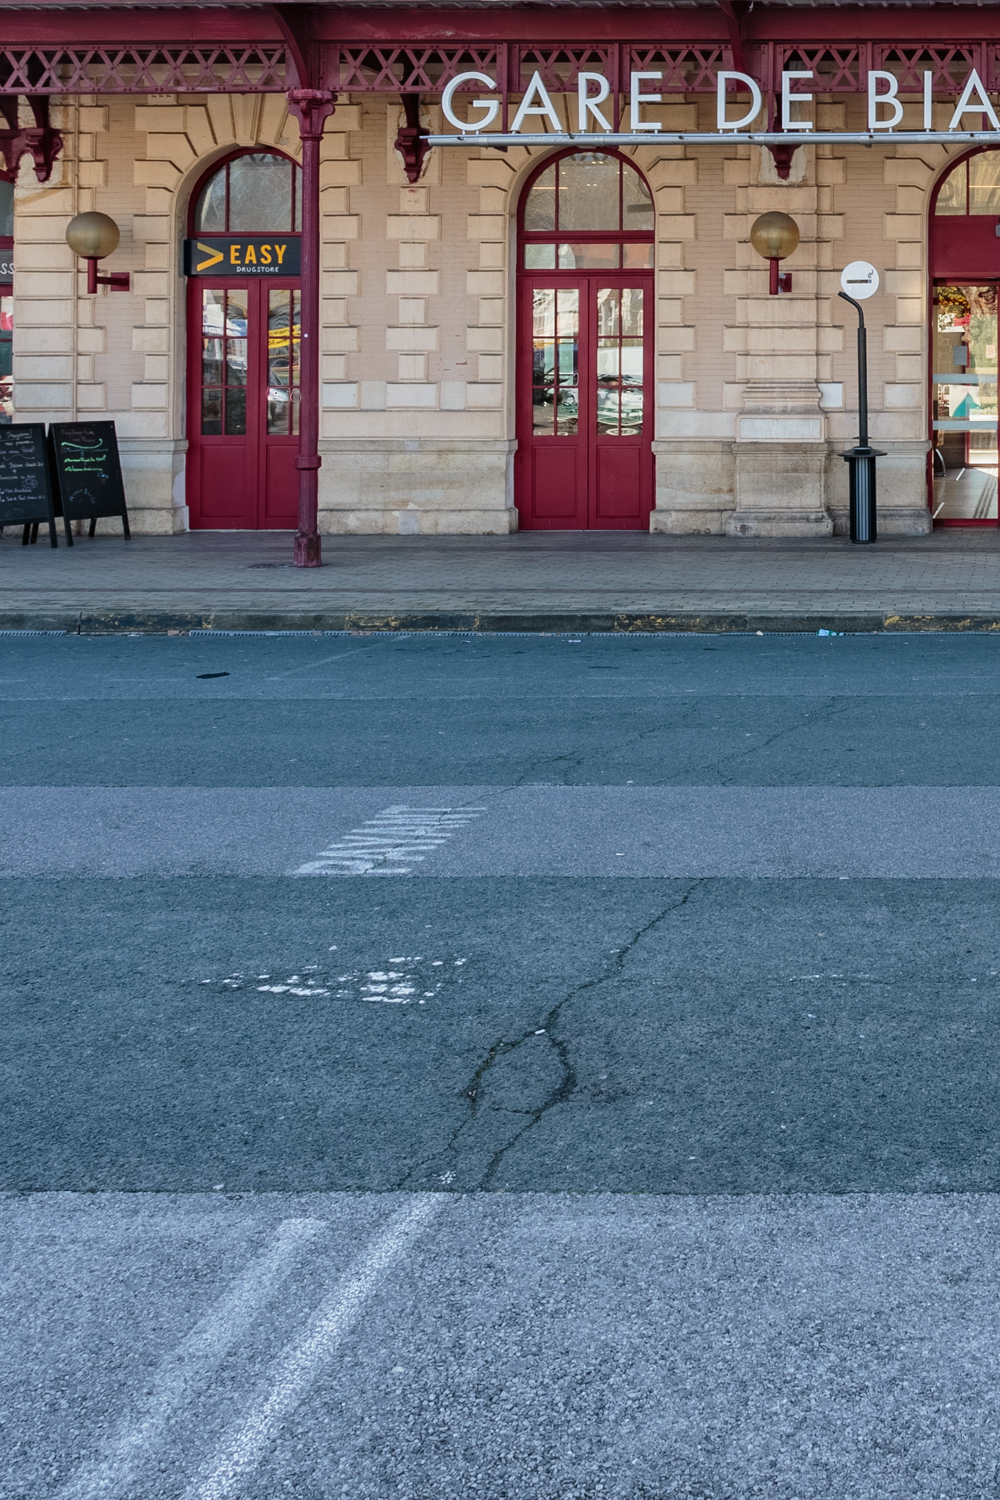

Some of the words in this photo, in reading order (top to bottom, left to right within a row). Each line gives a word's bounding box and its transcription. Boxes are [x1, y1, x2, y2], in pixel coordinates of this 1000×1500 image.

[442, 70, 663, 131] GARE
[717, 70, 813, 129] DE
[230, 245, 287, 264] EASY
